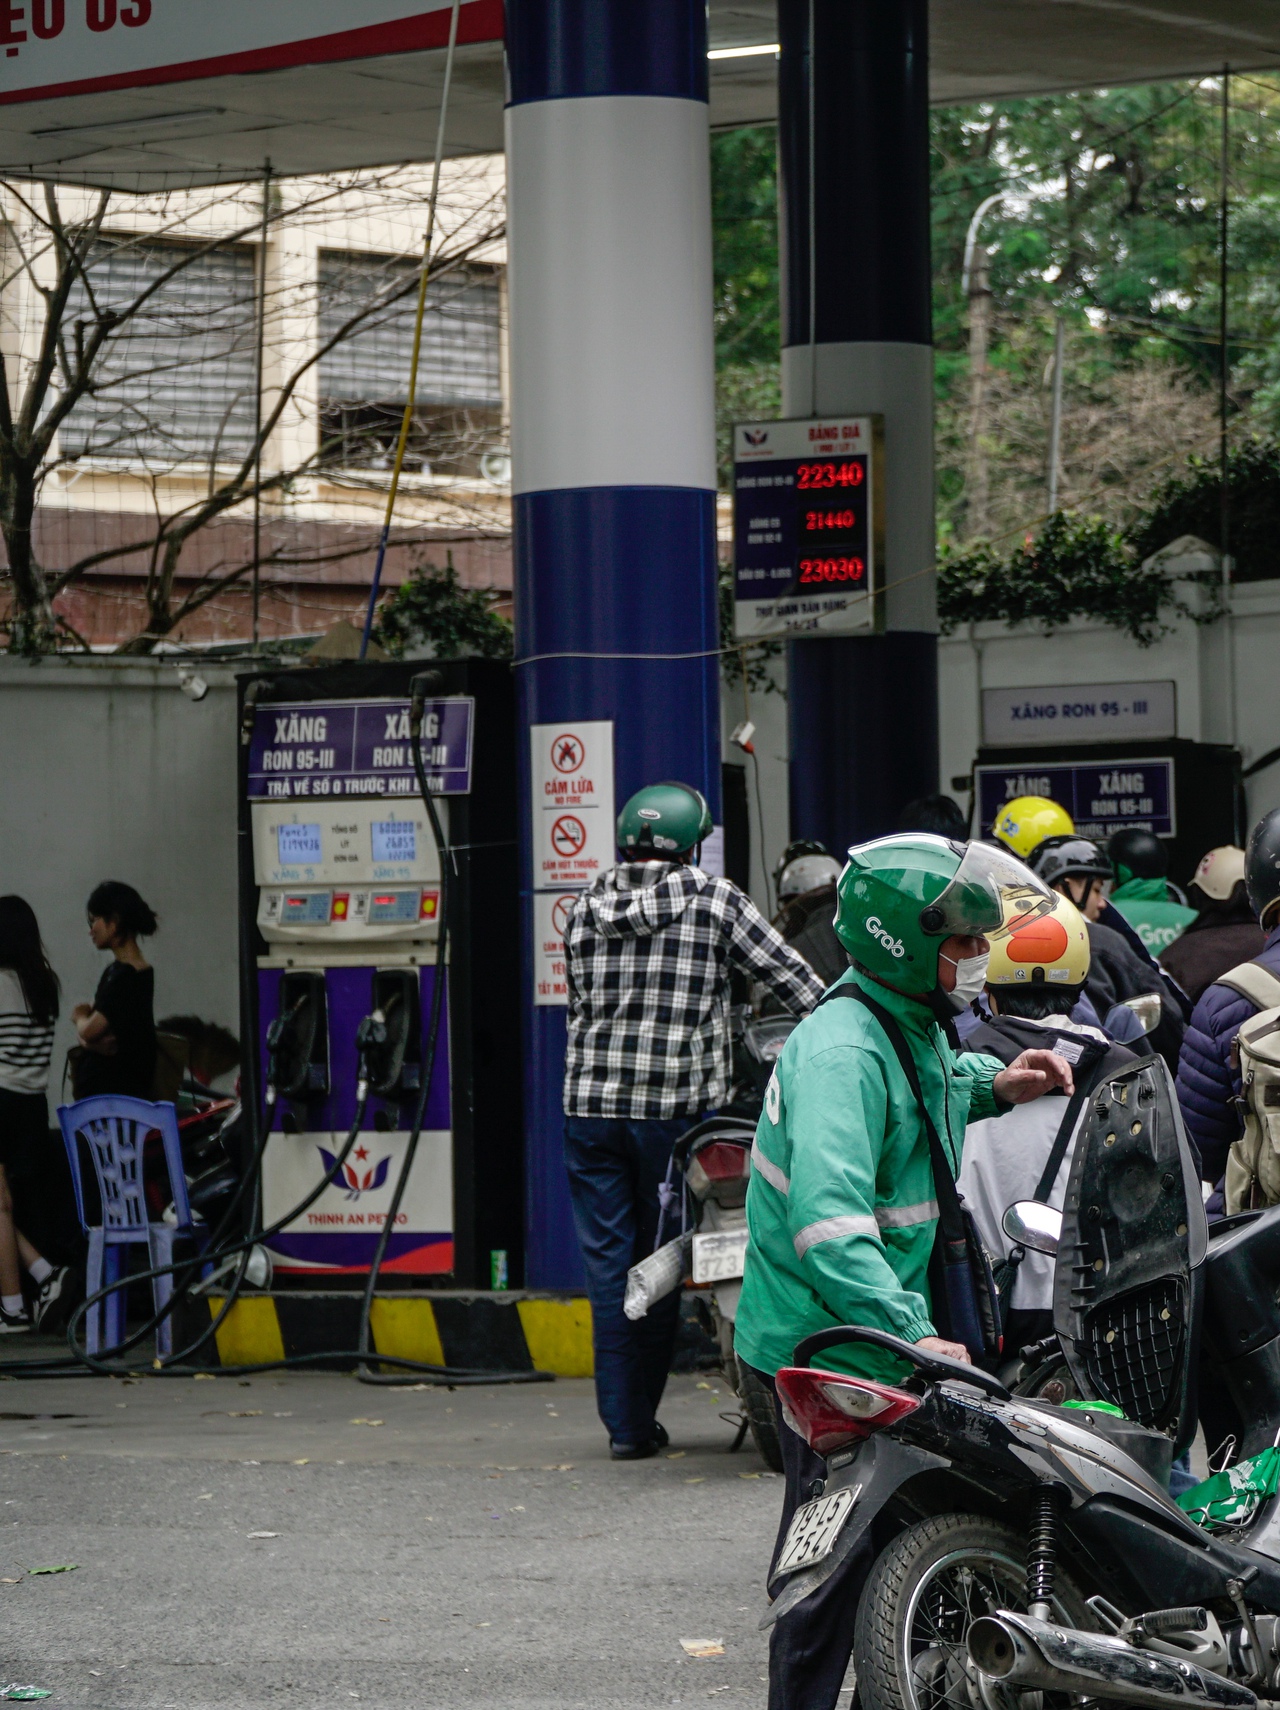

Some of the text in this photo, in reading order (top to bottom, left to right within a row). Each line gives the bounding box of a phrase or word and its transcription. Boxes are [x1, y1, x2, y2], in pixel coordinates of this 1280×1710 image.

[796, 461, 864, 489] 22340
[805, 509, 855, 530] 21440
[799, 557, 864, 583] 23030
[1011, 703, 1057, 720] XĂNG
[1062, 703, 1096, 718] RON
[1101, 701, 1119, 716] 95
[1133, 701, 1147, 715] III
[274, 711, 327, 744] XĂNG
[262, 749, 335, 771] RON 95-III
[372, 748, 403, 768] RON
[388, 776, 410, 793] KHI
[1005, 773, 1051, 798] XĂNG
[1099, 770, 1145, 795] XĂNG
[866, 916, 905, 958] Grab
[347, 1212, 365, 1225] AN
